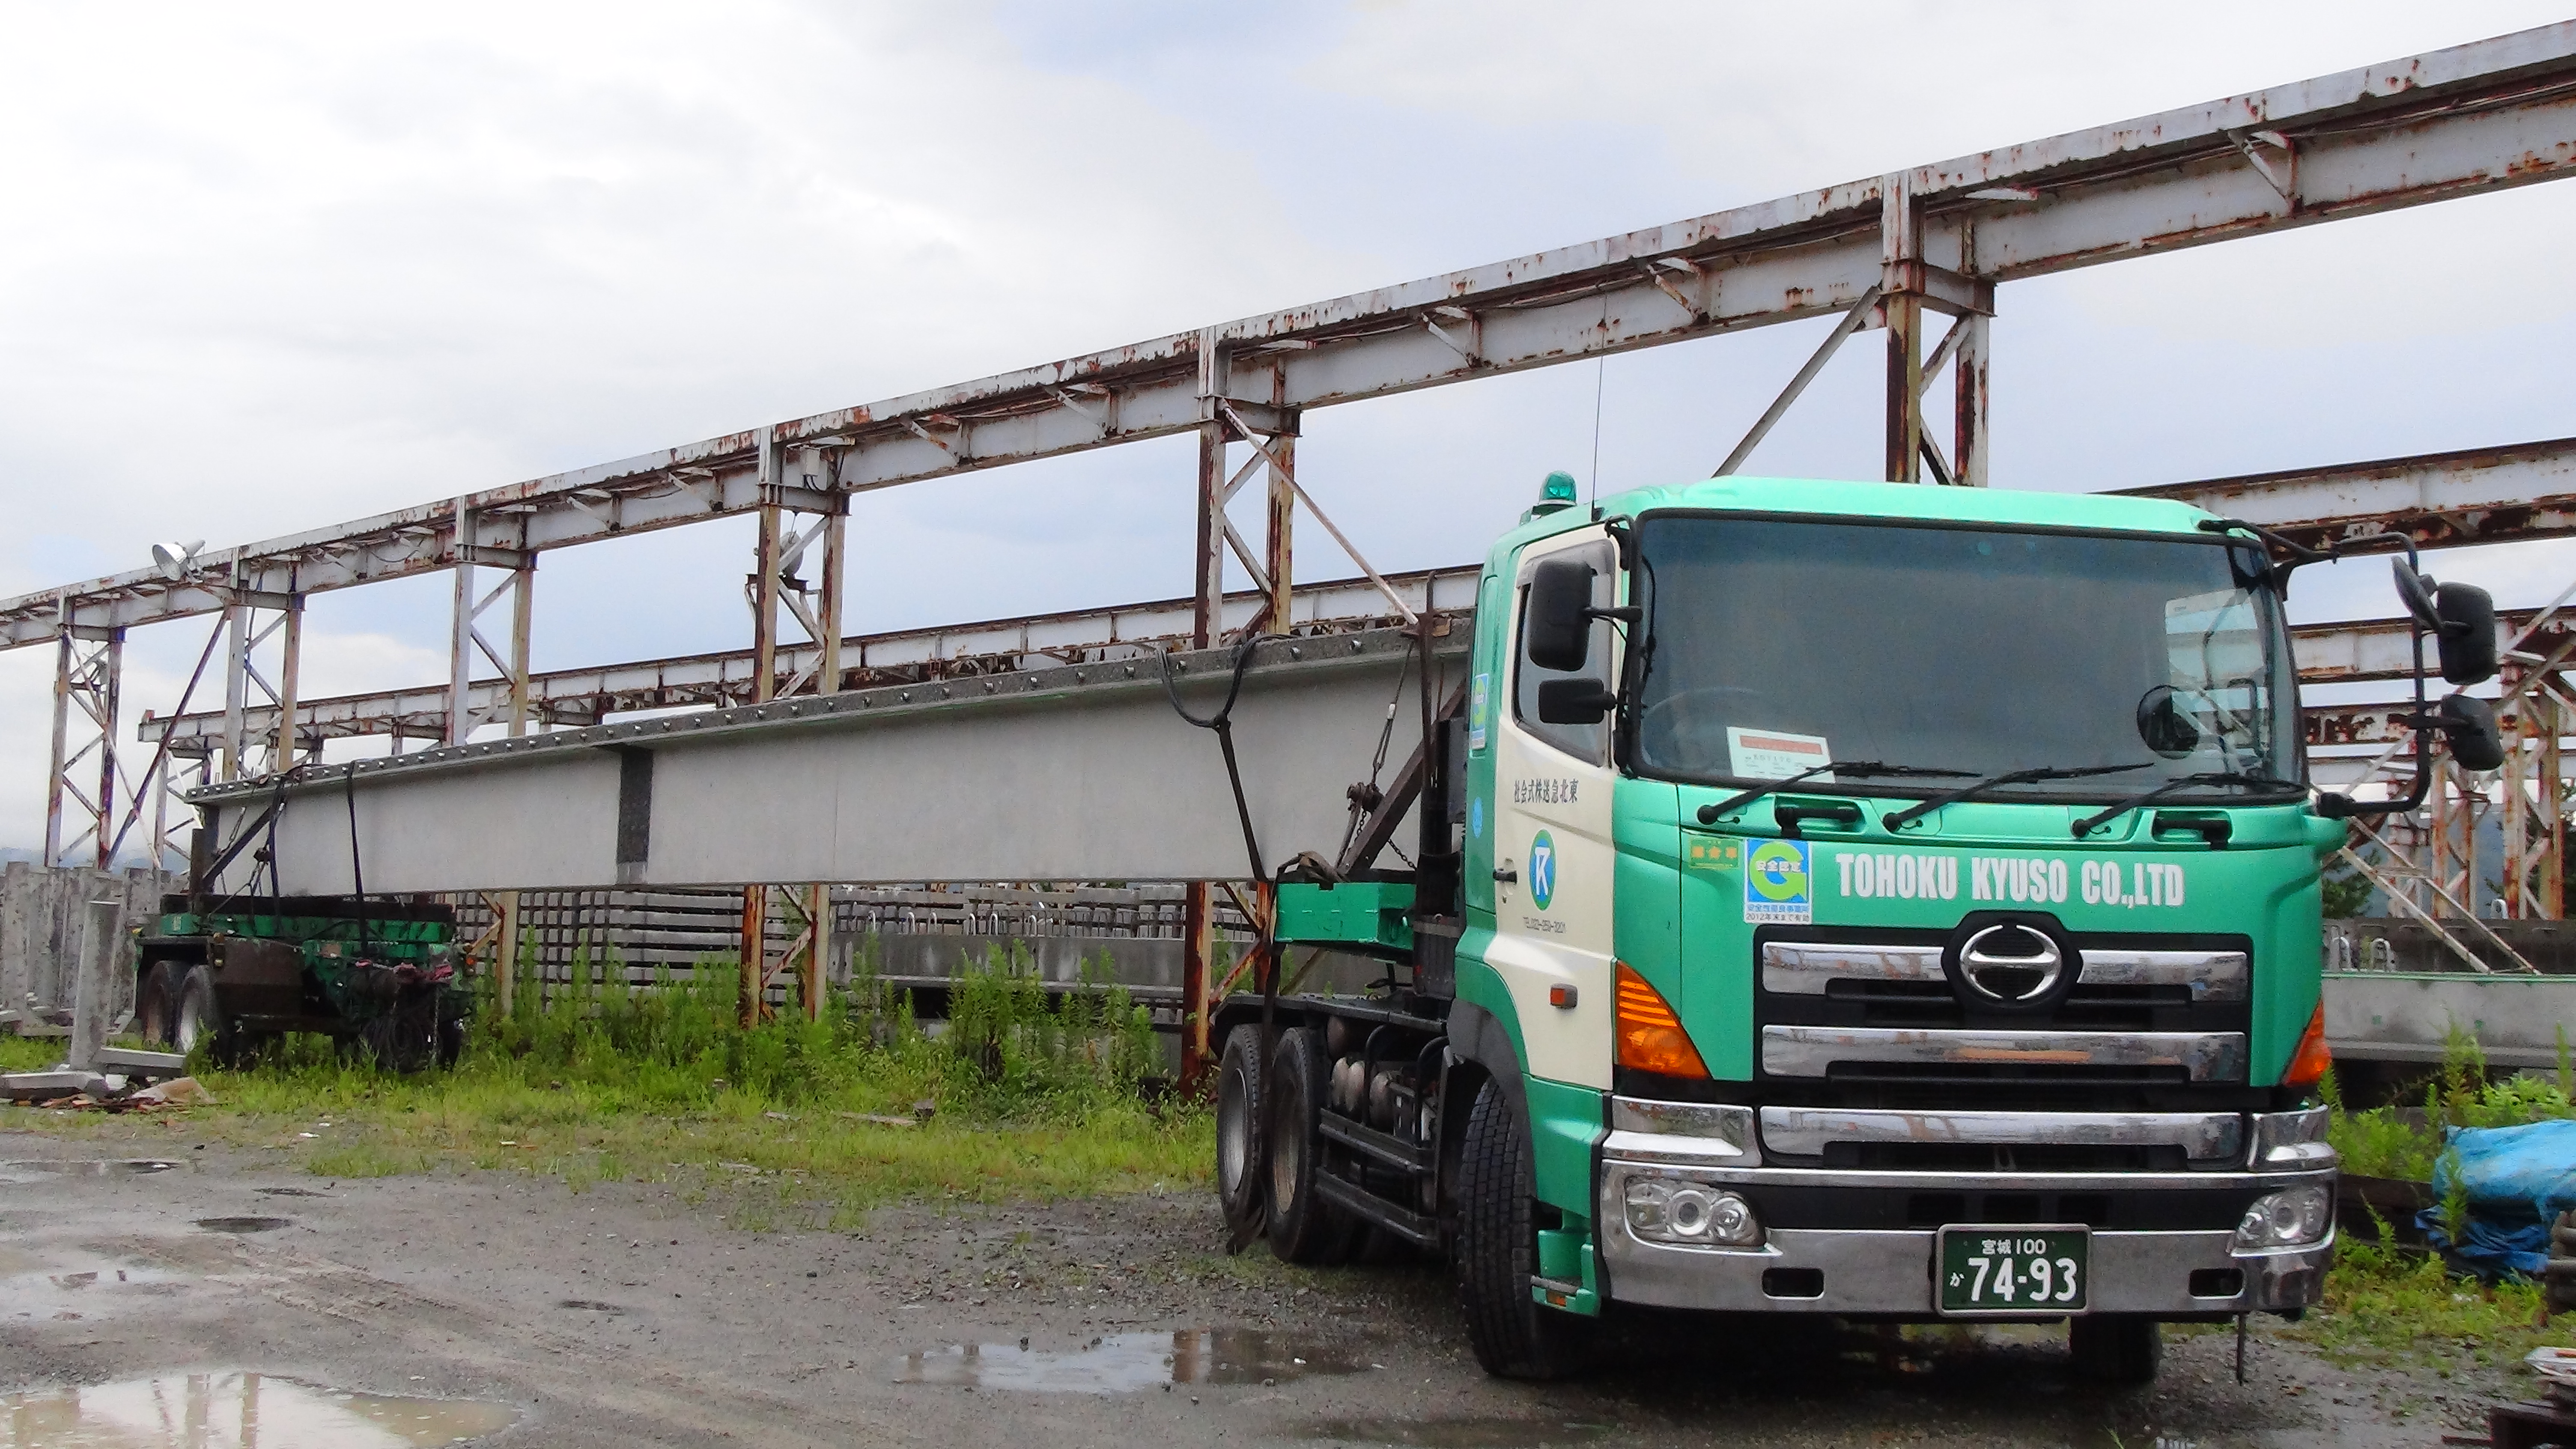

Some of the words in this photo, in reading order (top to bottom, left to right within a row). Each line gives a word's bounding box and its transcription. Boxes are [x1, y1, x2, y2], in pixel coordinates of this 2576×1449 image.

[1836, 853, 1957, 900] TOHOKU
[1971, 857, 2068, 903] KYUSO
[2081, 860, 2184, 909] CO.,LTD
[1968, 1257, 2077, 1301] 74-93
